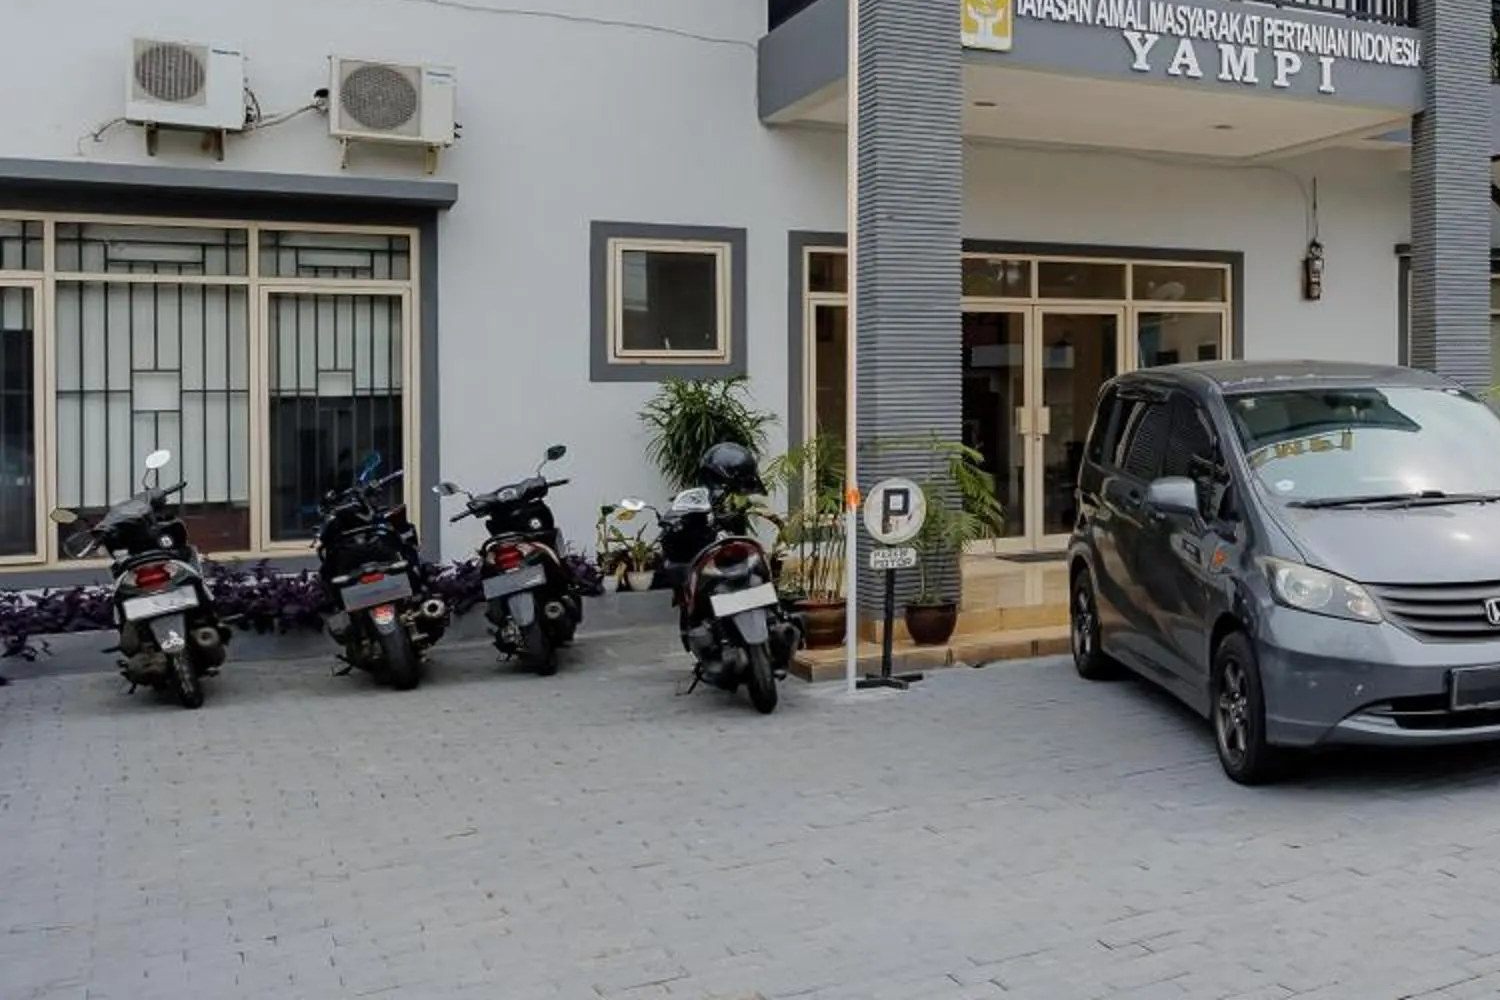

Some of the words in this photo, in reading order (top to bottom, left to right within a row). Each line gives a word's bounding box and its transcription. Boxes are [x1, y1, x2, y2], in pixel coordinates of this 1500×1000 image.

[1150, 0, 1261, 45] MASYARAKAT
[1263, 16, 1348, 57] PERTANIAN
[1123, 31, 1336, 93] YAMPI
[881, 488, 910, 535] P
